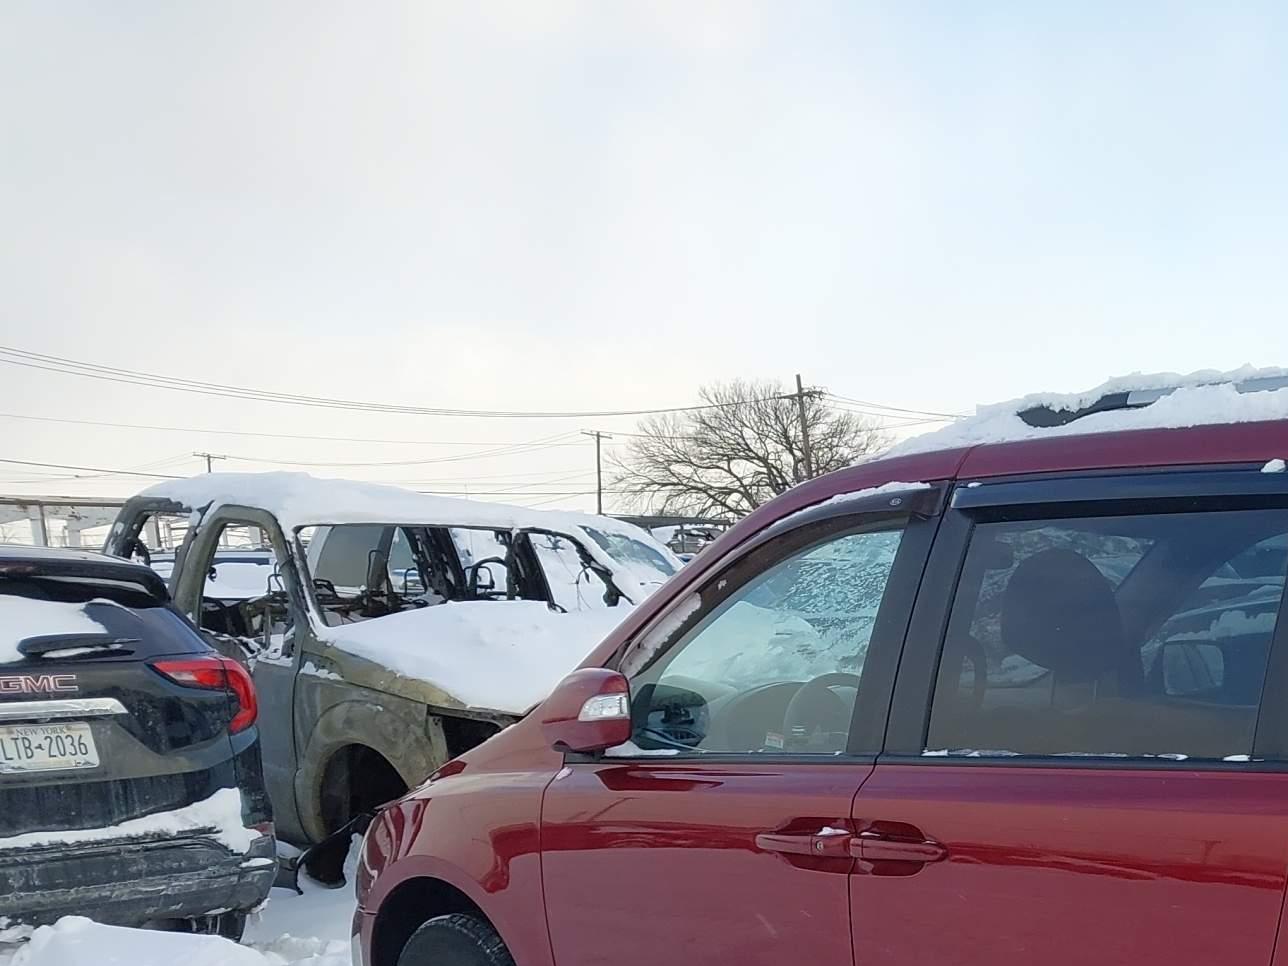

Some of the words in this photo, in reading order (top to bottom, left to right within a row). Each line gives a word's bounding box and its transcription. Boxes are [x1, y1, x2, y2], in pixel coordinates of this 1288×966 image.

[0, 675, 79, 693] GMC
[16, 727, 37, 736] NEW
[40, 726, 65, 735] YORK
[44, 734, 88, 758] 2036
